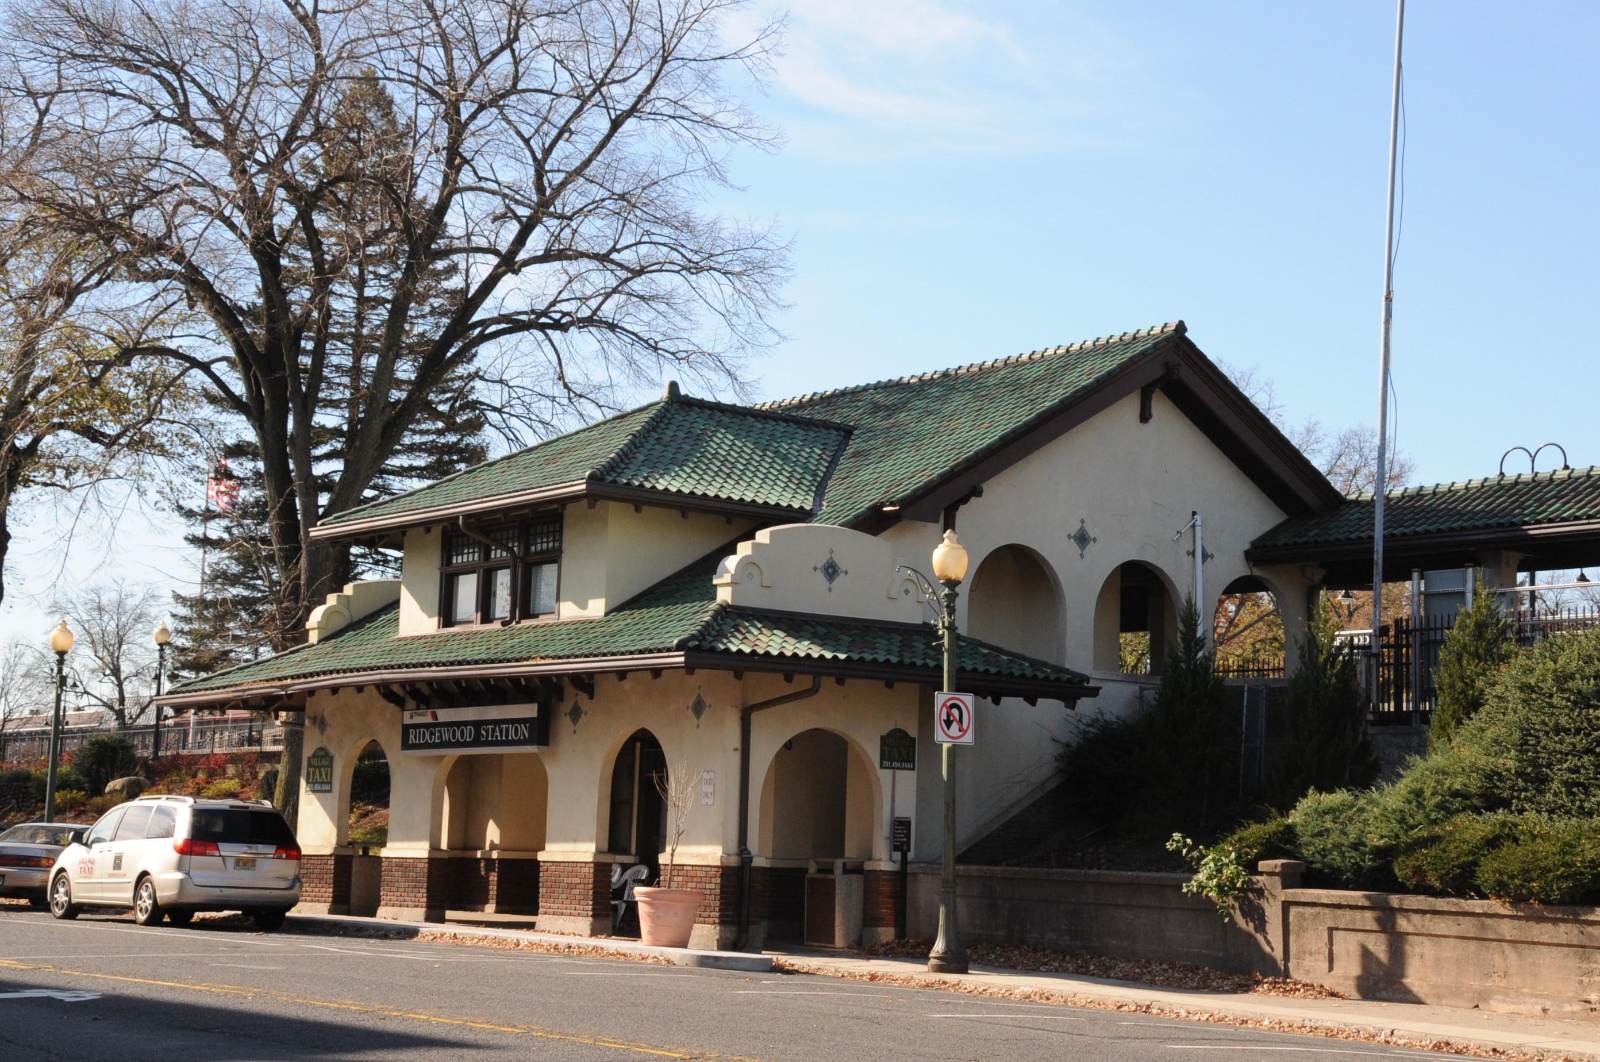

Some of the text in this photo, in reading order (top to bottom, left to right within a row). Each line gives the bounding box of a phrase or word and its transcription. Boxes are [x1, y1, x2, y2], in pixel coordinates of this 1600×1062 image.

[408, 722, 530, 745] RIDGEWOOD STATION
[308, 767, 331, 782] TAXI
[79, 865, 95, 875] TAXI
